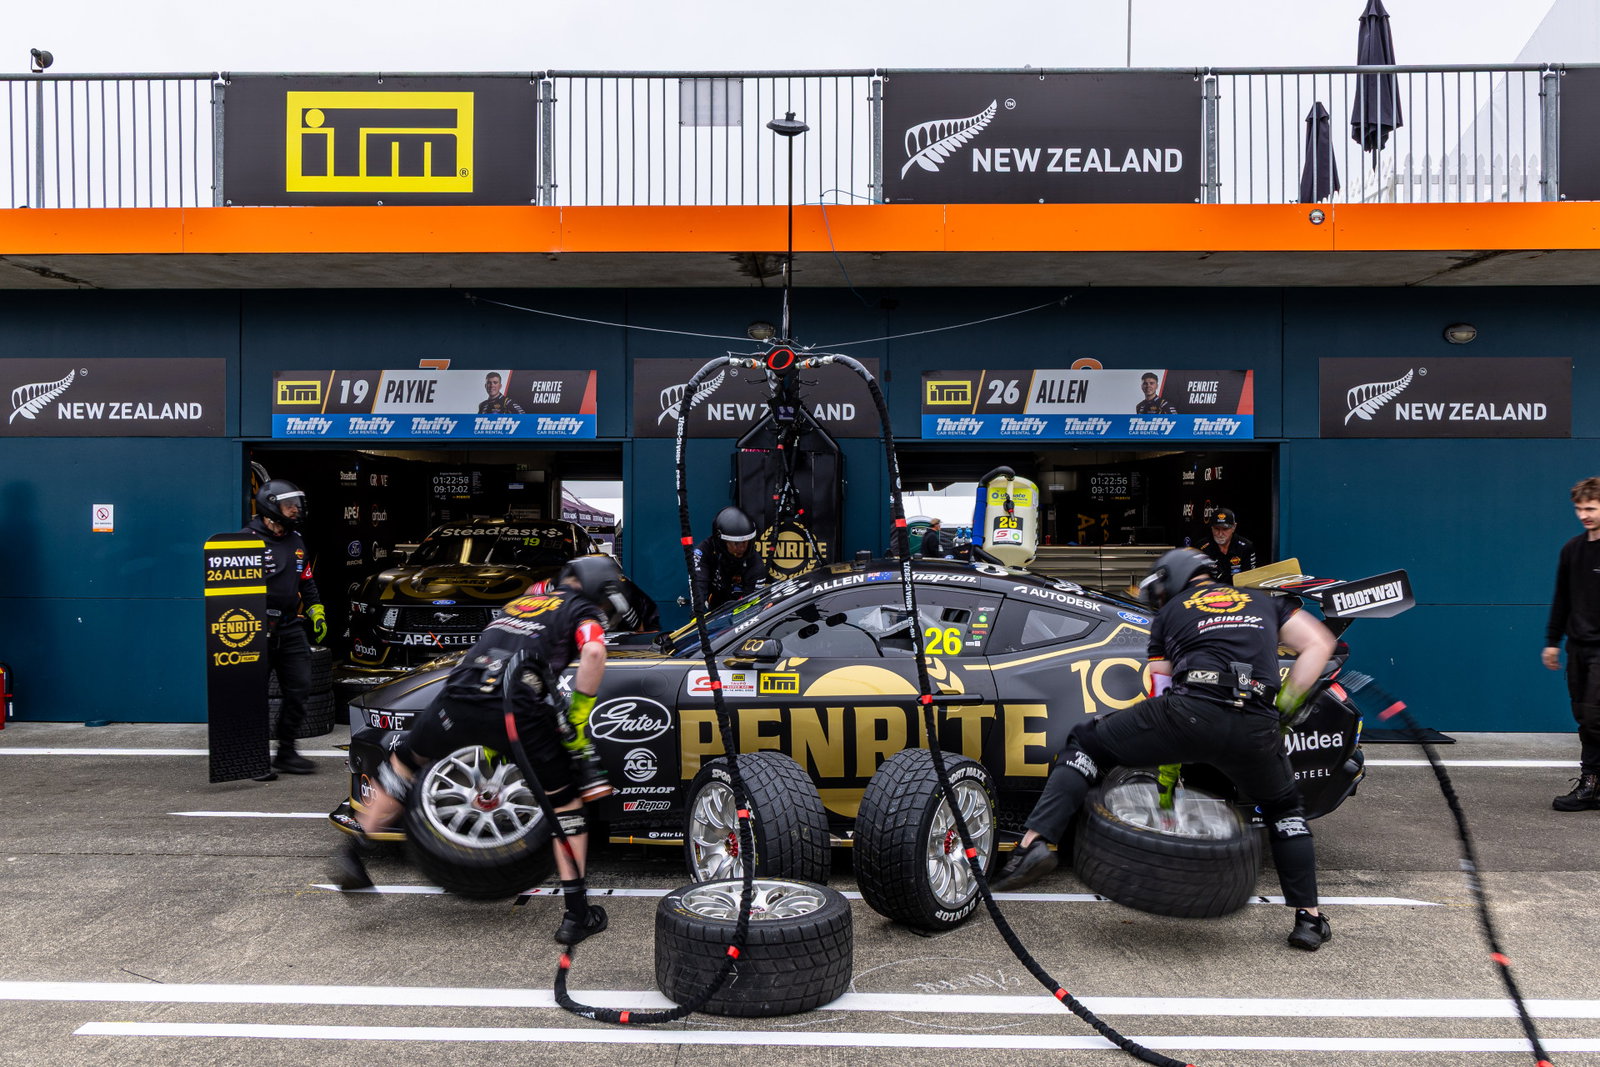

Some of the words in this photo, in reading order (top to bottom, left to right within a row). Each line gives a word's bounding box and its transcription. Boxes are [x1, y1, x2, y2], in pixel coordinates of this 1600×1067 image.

[972, 148, 1041, 172] NEW
[1047, 148, 1183, 172] ZEALAND
[340, 379, 369, 404] 19
[384, 380, 437, 403] PAYNE
[532, 381, 563, 392] PENRITE
[986, 379, 1020, 404] 26
[1036, 380, 1089, 404] ALLEN
[1187, 381, 1219, 392] PENRITE
[533, 392, 561, 404] RACING
[1189, 392, 1217, 404] RACING
[58, 402, 104, 420] NEW
[108, 402, 202, 420] ZEALAND
[707, 403, 755, 421] NEW
[1395, 403, 1445, 421] NEW
[1449, 403, 1547, 421] ZEALAND
[286, 417, 332, 434] Thrifty
[349, 417, 395, 434] Thrifty
[412, 417, 458, 434] Thrifty
[474, 417, 520, 434] Thrifty
[537, 417, 584, 434] Thrifty
[936, 418, 984, 435] Thrifty
[1000, 418, 1048, 435] Thrifty
[1064, 418, 1112, 435] Thrifty
[1129, 418, 1176, 435] Thrifty
[1193, 418, 1241, 435] Thrifty
[999, 516, 1018, 528] 26
[522, 537, 540, 546] 19
[208, 557, 222, 568] 19
[223, 556, 262, 567] PAYNE
[207, 570, 222, 581] 26
[224, 568, 262, 580] ALLEN
[812, 574, 864, 594] ALLEN
[1030, 587, 1102, 612] AUTODESK
[1332, 580, 1404, 614] Floorway
[1120, 611, 1146, 624] Ford
[1198, 616, 1244, 628] RACING
[211, 620, 262, 634] PENRITE
[403, 633, 443, 647] APEX
[742, 639, 764, 652] 100
[924, 627, 962, 655] 26
[213, 651, 241, 666] 100
[370, 714, 404, 730] GROVE
[590, 702, 669, 738] Gates
[1284, 730, 1343, 756] Midea
[624, 760, 658, 771] ACL
[1294, 768, 1330, 780] STEEL
[620, 786, 675, 794] DUNLOP
[635, 800, 670, 812] Repco
[935, 898, 976, 922] DUNLOP
